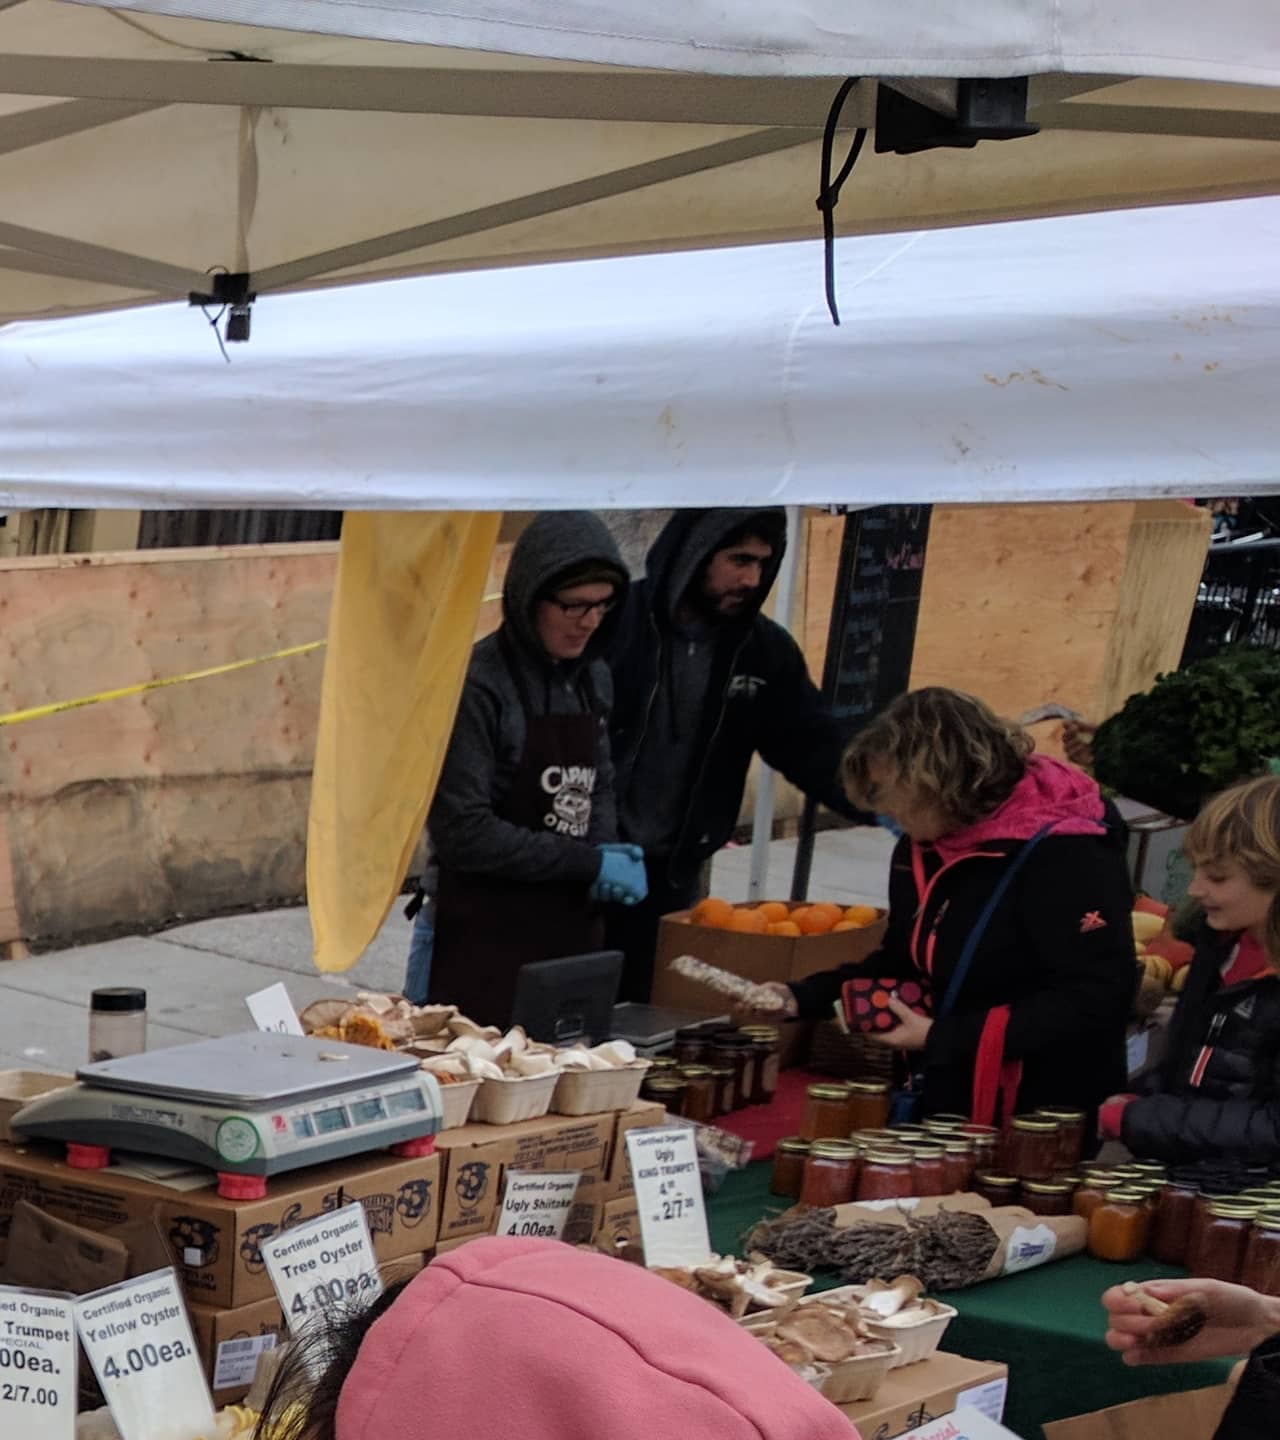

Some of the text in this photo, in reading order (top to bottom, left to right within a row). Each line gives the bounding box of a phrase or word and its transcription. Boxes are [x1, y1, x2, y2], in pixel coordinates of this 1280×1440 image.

[655, 1149, 675, 1162] Ugly
[506, 1200, 530, 1212] Ugly
[273, 1220, 359, 1259] Certified Organic
[281, 1240, 363, 1279] Tree Oyster
[83, 1286, 171, 1320] Certified Organic
[291, 1272, 378, 1315] 4.00ea.
[20, 1304, 66, 1319] Organic
[86, 1305, 181, 1343] Yellow Oyster
[4, 1321, 71, 1342] Trumpet
[103, 1339, 192, 1380] 4.00ea.
[2, 1384, 58, 1406] 2/7.00
